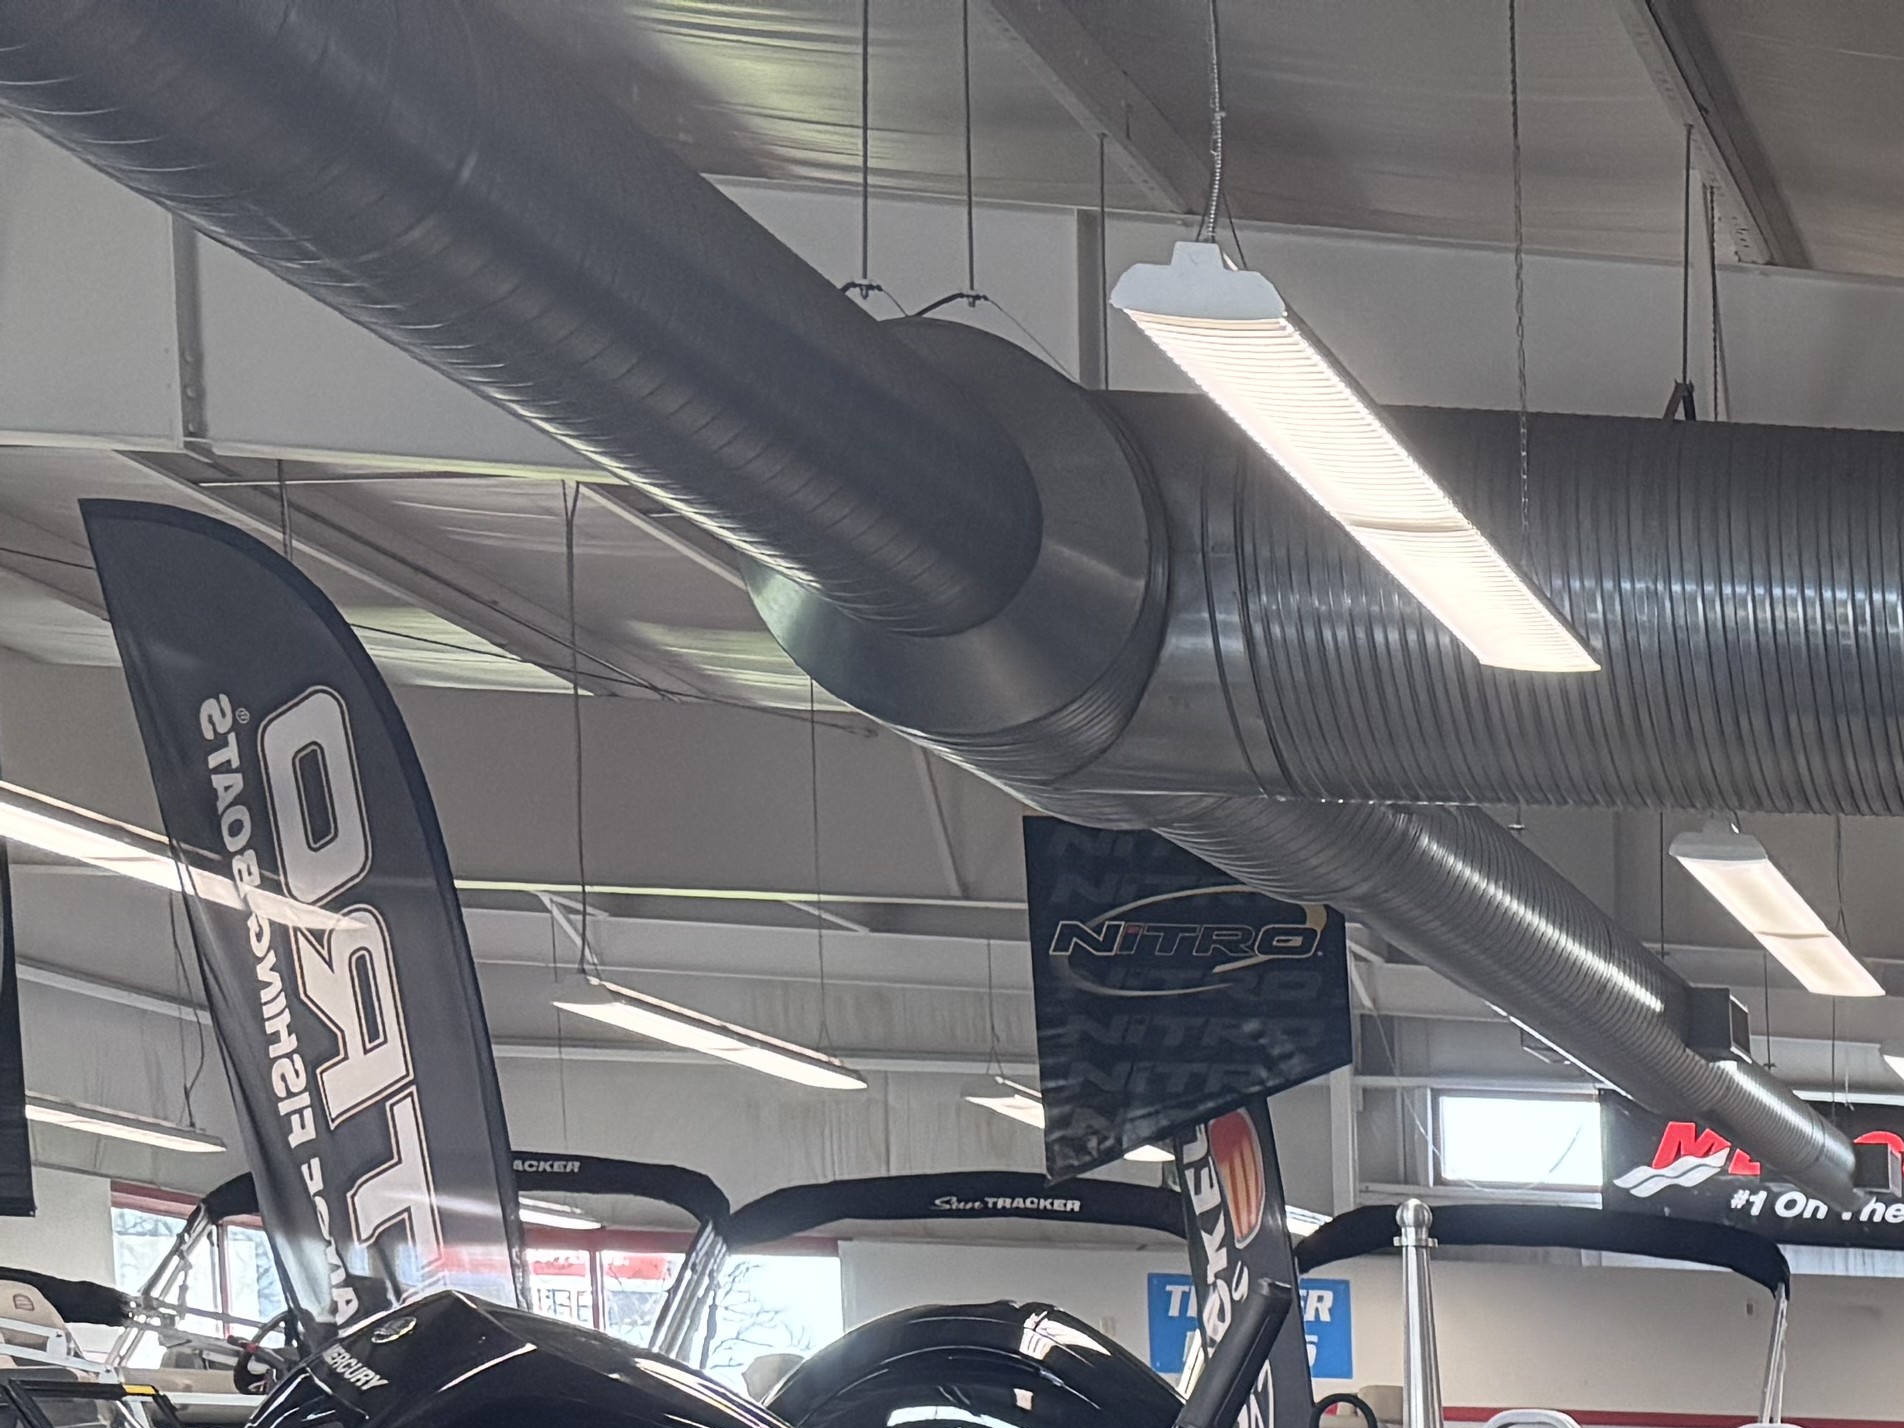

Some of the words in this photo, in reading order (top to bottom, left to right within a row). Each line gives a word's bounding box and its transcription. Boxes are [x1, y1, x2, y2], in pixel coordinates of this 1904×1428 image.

[513, 1159, 581, 1173] ACKER
[984, 1197, 1082, 1212] TRACKER
[1730, 1189, 1763, 1218] #1
[1774, 1190, 1828, 1221] On
